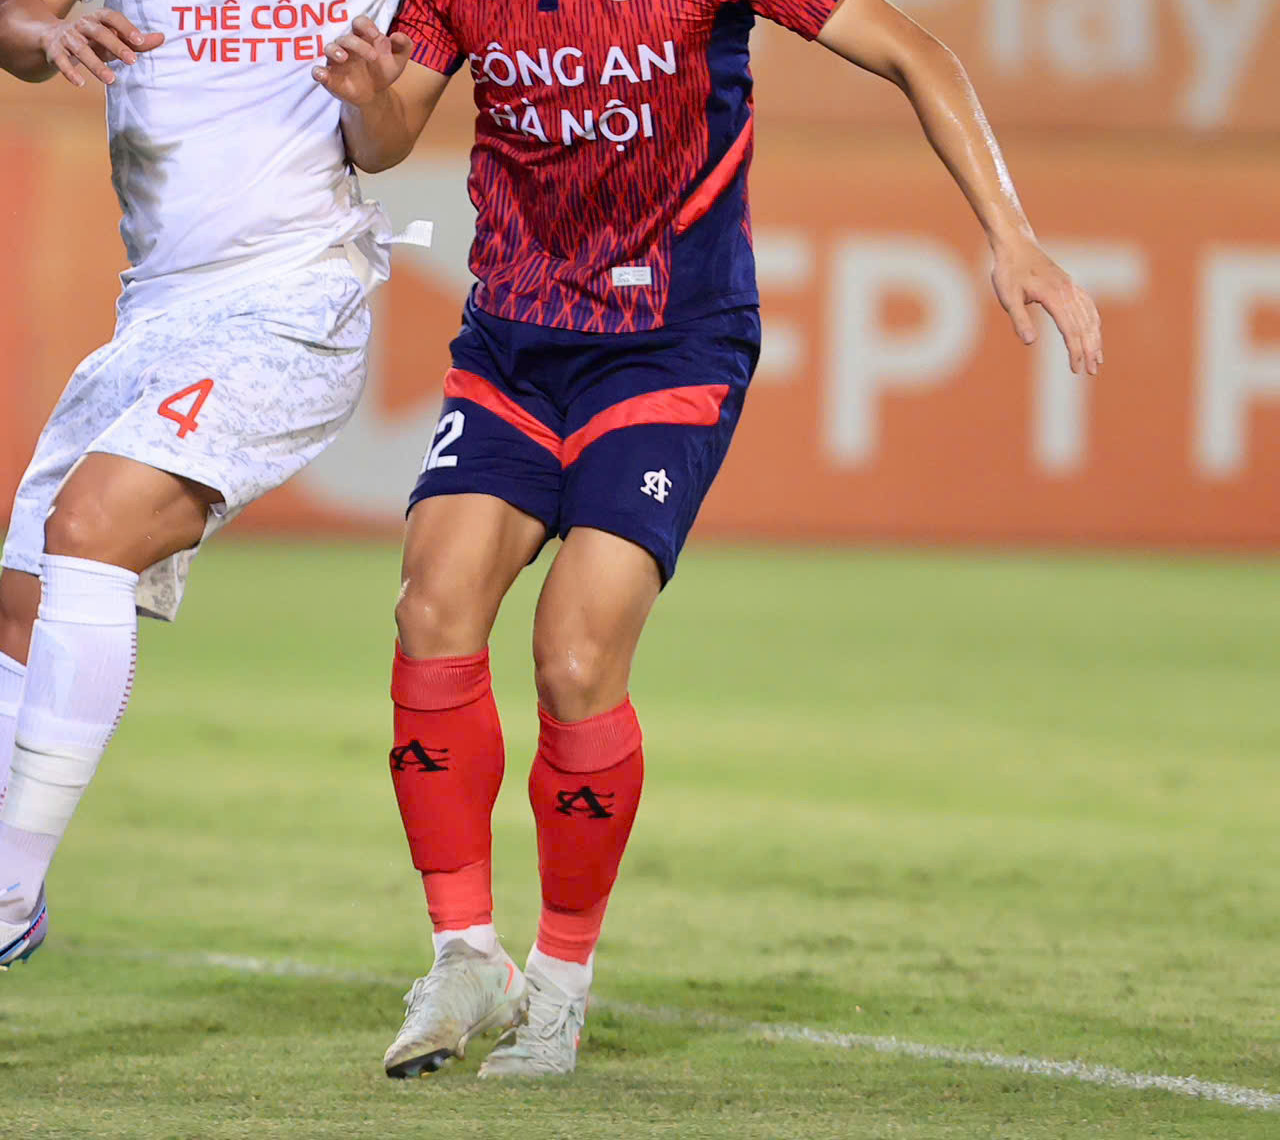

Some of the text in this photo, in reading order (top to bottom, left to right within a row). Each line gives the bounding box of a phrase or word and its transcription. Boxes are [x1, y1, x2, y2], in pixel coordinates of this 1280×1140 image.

[185, 34, 328, 63] VIETTEL
[599, 40, 677, 86] AN
[489, 97, 654, 152] HÀ NỘI
[157, 378, 215, 440] 4
